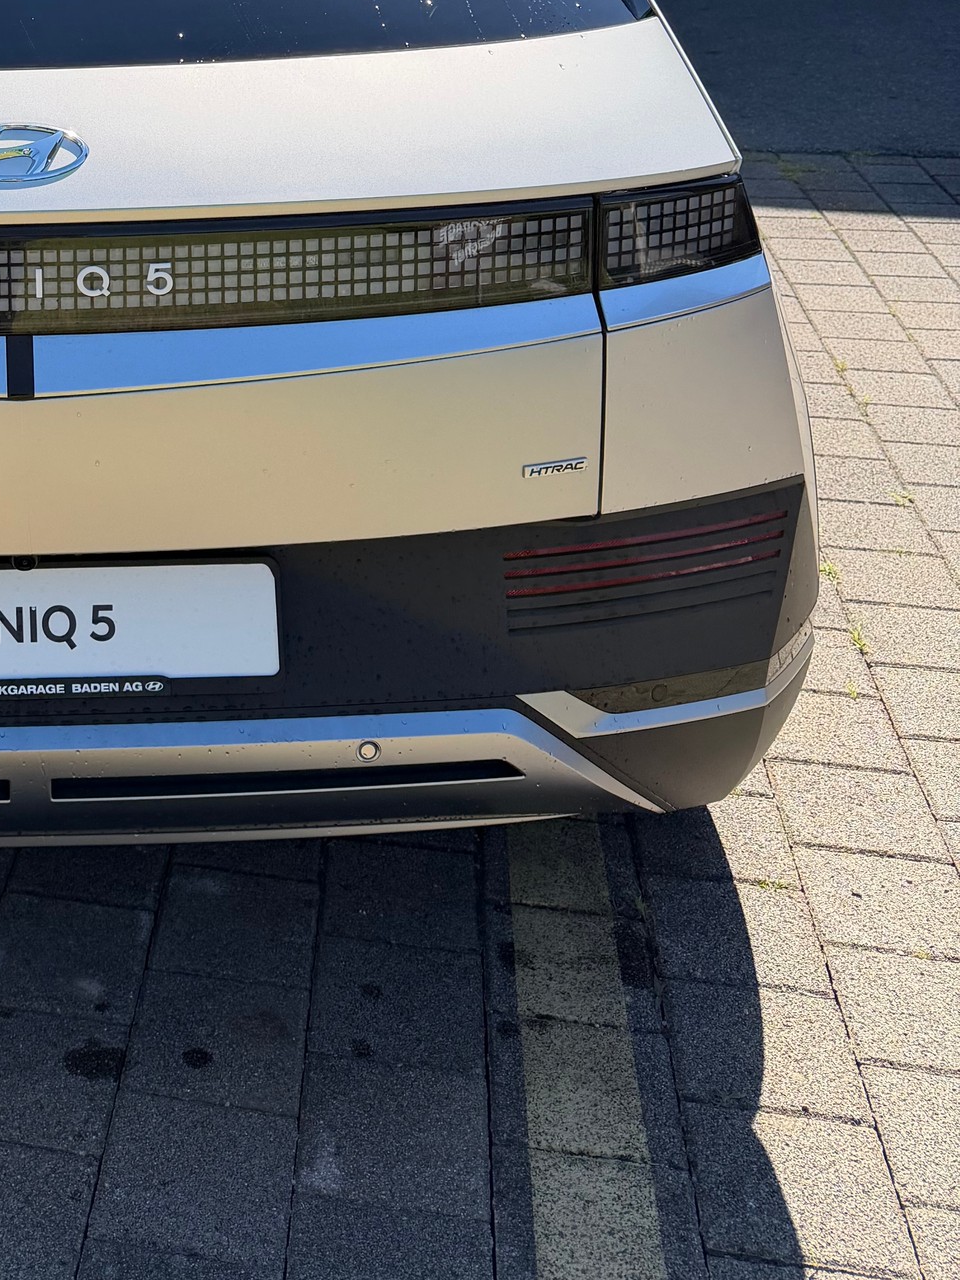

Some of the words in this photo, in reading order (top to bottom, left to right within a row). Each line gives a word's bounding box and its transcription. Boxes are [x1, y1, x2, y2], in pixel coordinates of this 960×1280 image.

[529, 460, 585, 477] HTRAC
[89, 604, 116, 643] 5
[71, 682, 120, 694] BADEN
[122, 681, 143, 693] AG
